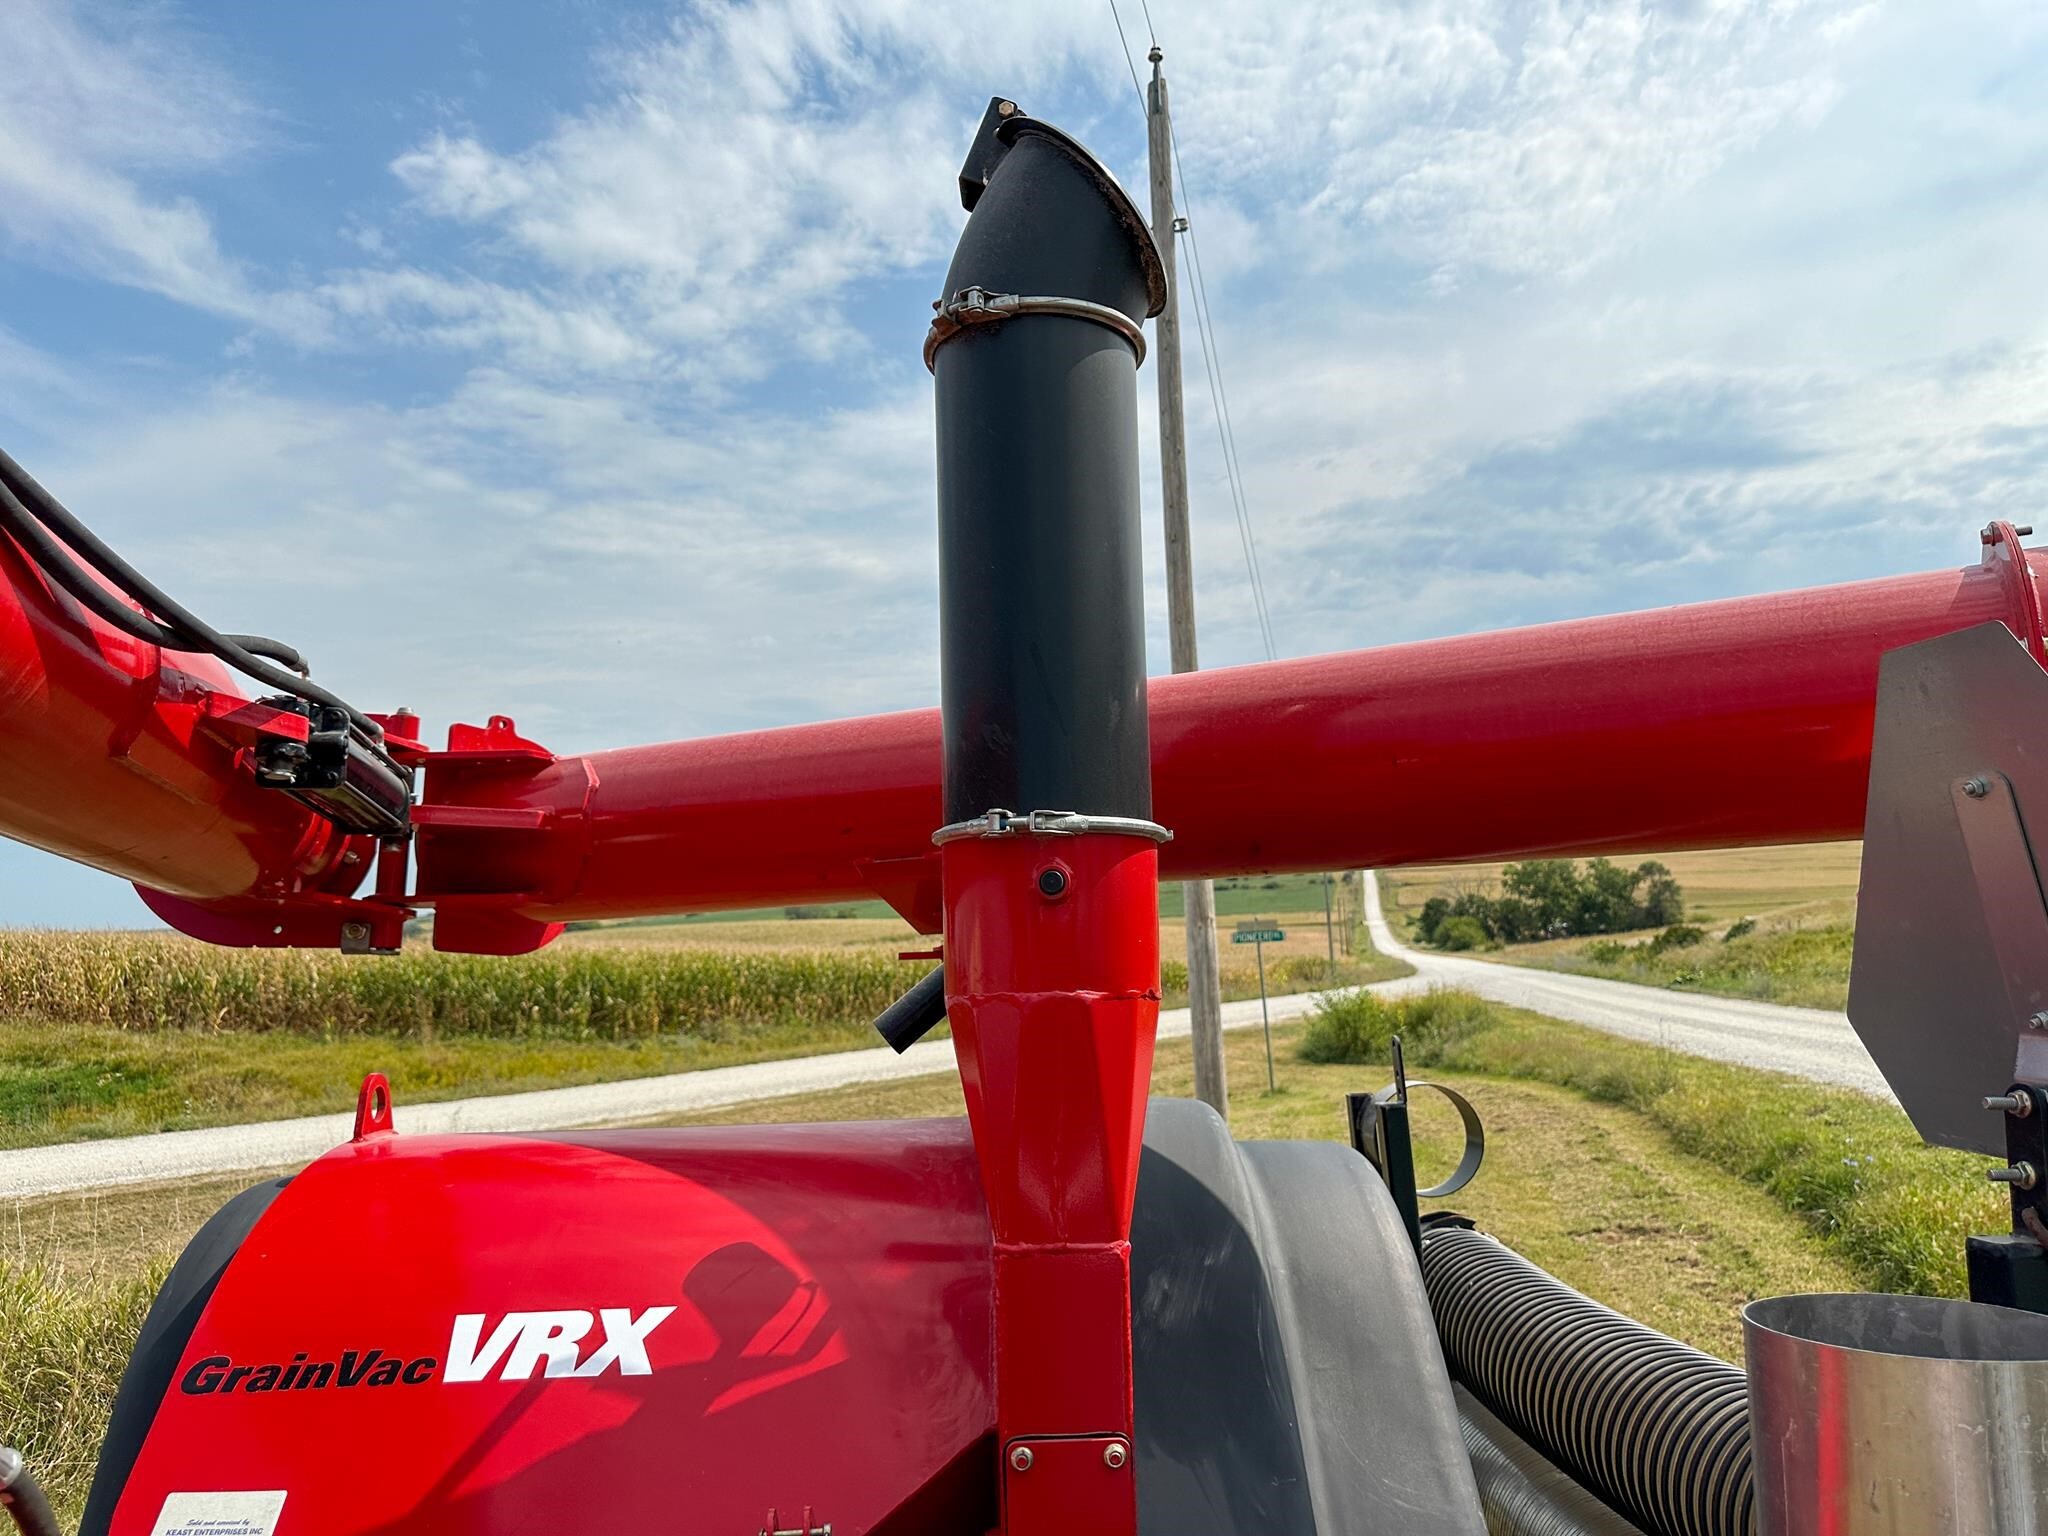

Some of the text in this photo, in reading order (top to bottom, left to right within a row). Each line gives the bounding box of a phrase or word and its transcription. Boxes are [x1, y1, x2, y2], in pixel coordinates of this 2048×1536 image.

[181, 1306, 676, 1395] GrainVac VRX
[166, 1528, 193, 1536] KEAST
[194, 1528, 248, 1536] ENTERPRISES
